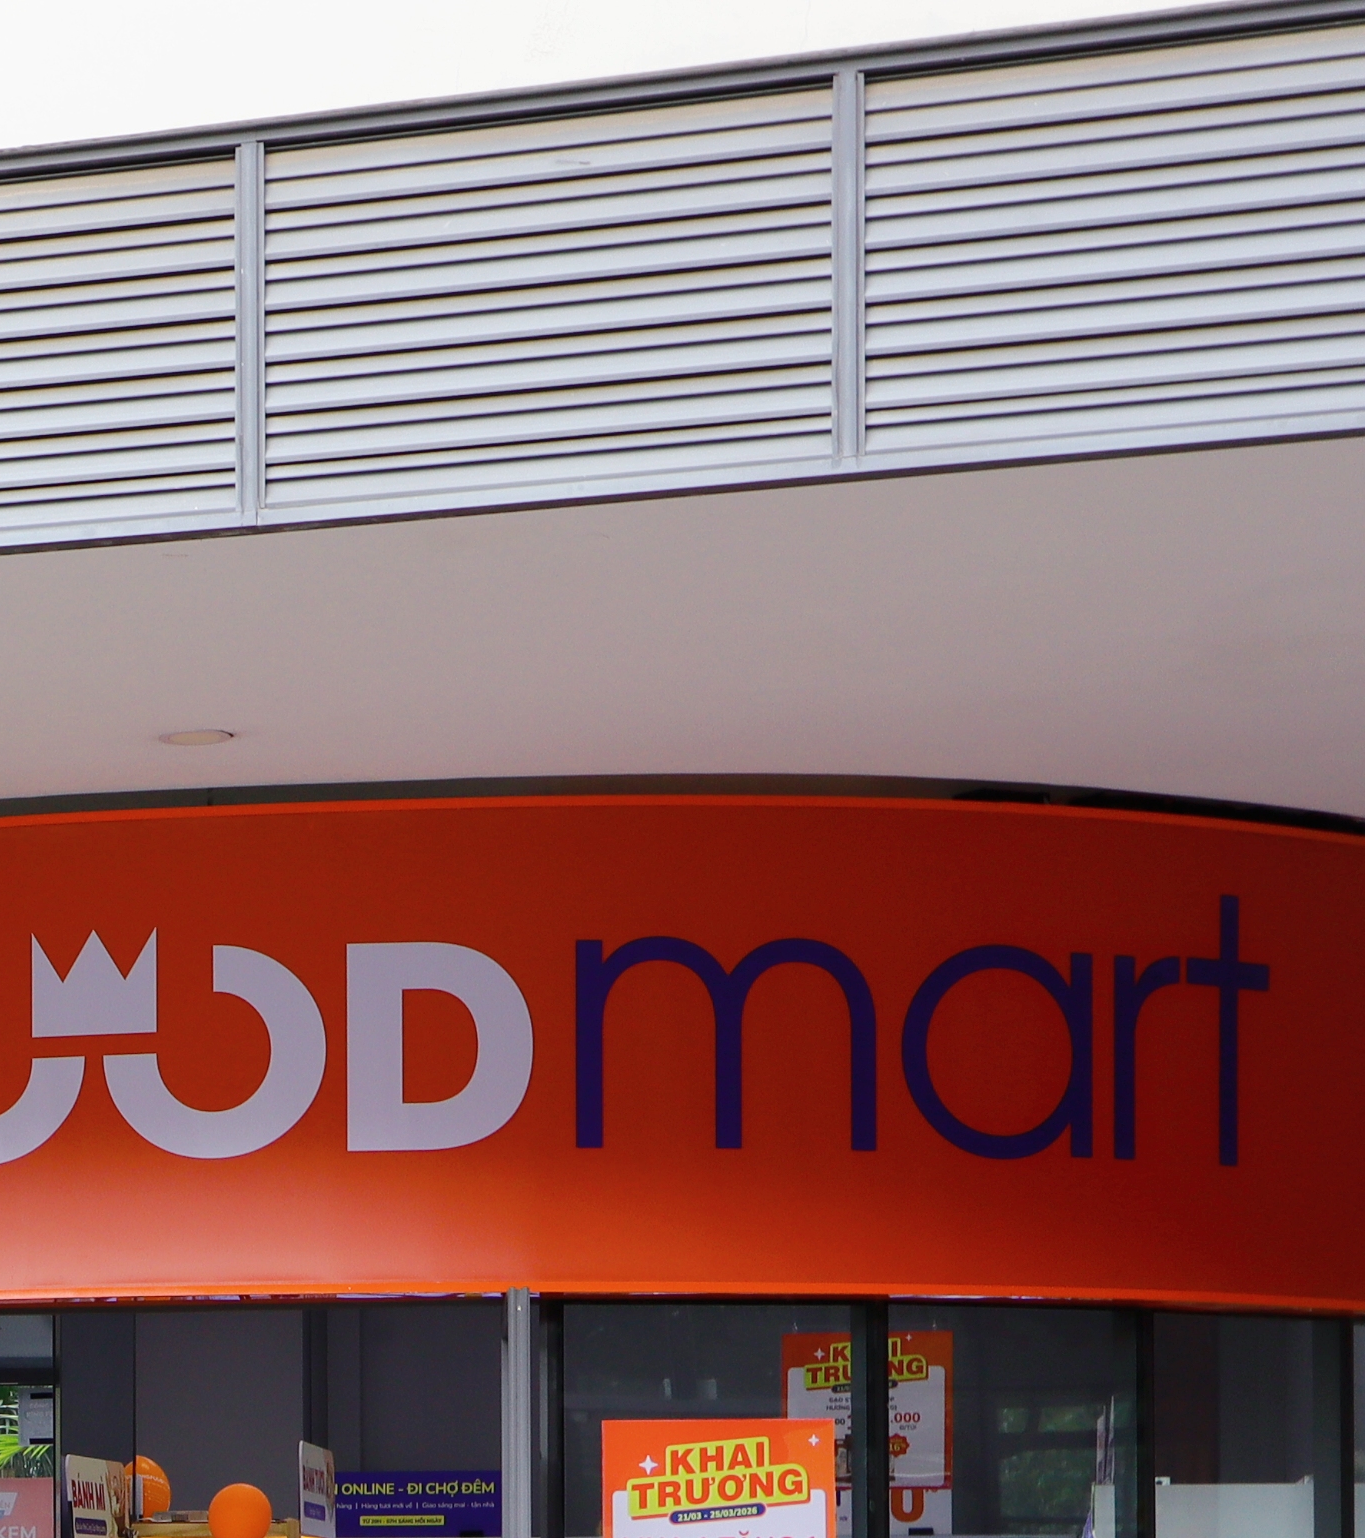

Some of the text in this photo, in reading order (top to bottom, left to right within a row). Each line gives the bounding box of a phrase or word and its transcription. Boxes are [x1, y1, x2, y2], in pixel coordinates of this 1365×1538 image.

[670, 1441, 765, 1476] KHAI
[341, 1483, 394, 1496] ONLINE
[407, 1483, 422, 1495] ĐI
[426, 1480, 459, 1498] CHỢ
[461, 1478, 495, 1494] ĐÊM
[631, 1468, 804, 1510] TRƯƠNG
[677, 1511, 702, 1522] 21/03
[709, 1506, 758, 1519] 25/03/2026
